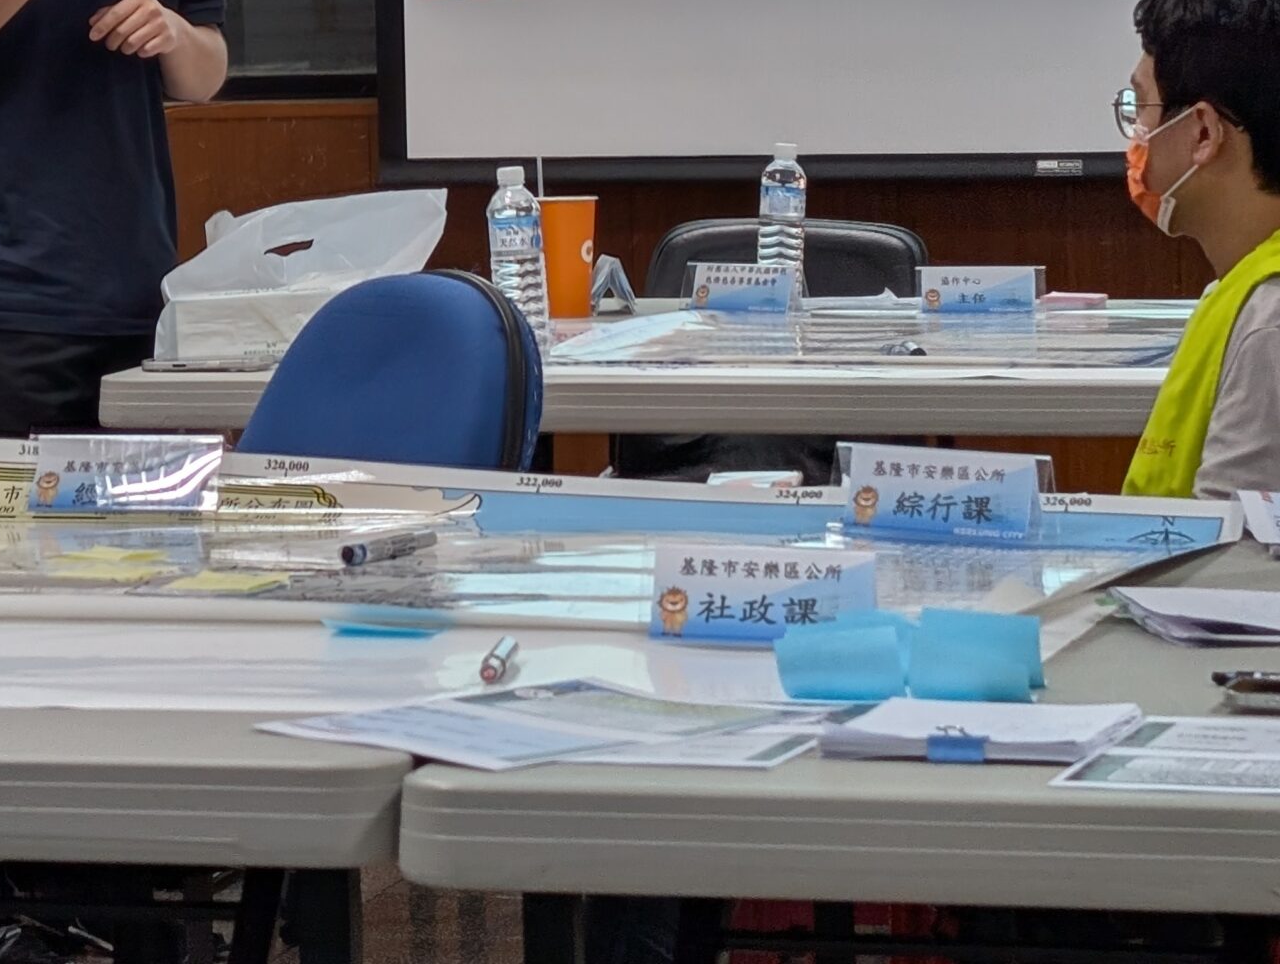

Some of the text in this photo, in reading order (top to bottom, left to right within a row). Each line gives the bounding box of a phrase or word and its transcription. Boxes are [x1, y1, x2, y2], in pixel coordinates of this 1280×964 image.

[872, 460, 1006, 483] 基隆市安樂區公所
[892, 491, 993, 524] 綜行課
[680, 557, 842, 582] 基隆市安樂區公所
[696, 592, 819, 626] 社政課
